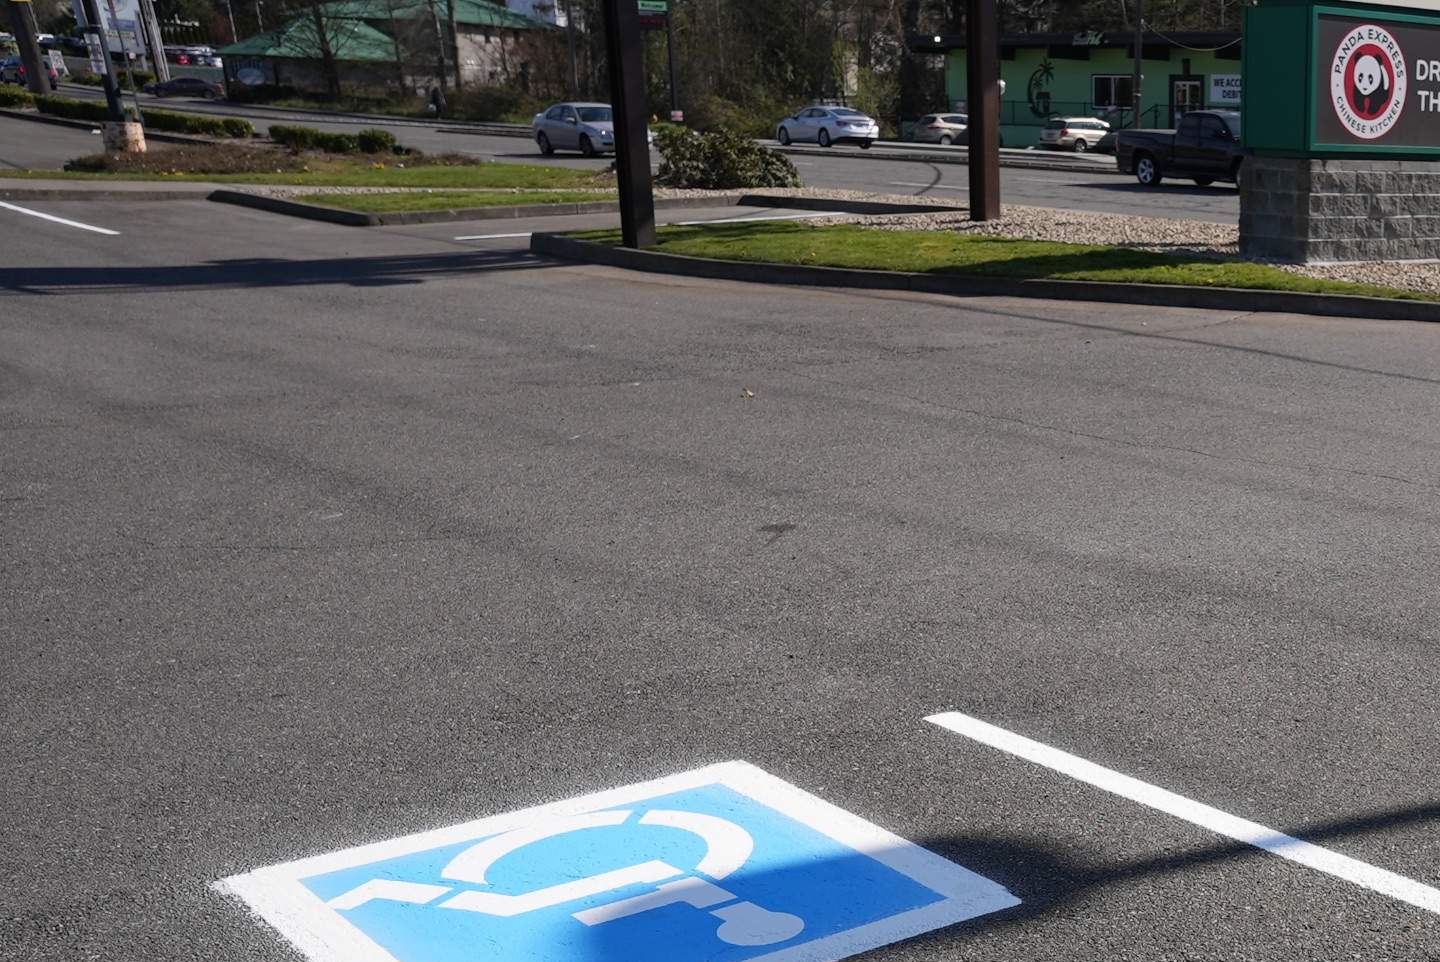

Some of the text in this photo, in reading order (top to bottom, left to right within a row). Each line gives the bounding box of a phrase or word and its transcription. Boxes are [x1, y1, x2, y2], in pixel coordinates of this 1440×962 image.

[1335, 29, 1404, 78] PANDA EXPRESS
[1336, 96, 1400, 134] CHINESE KITCHEN
